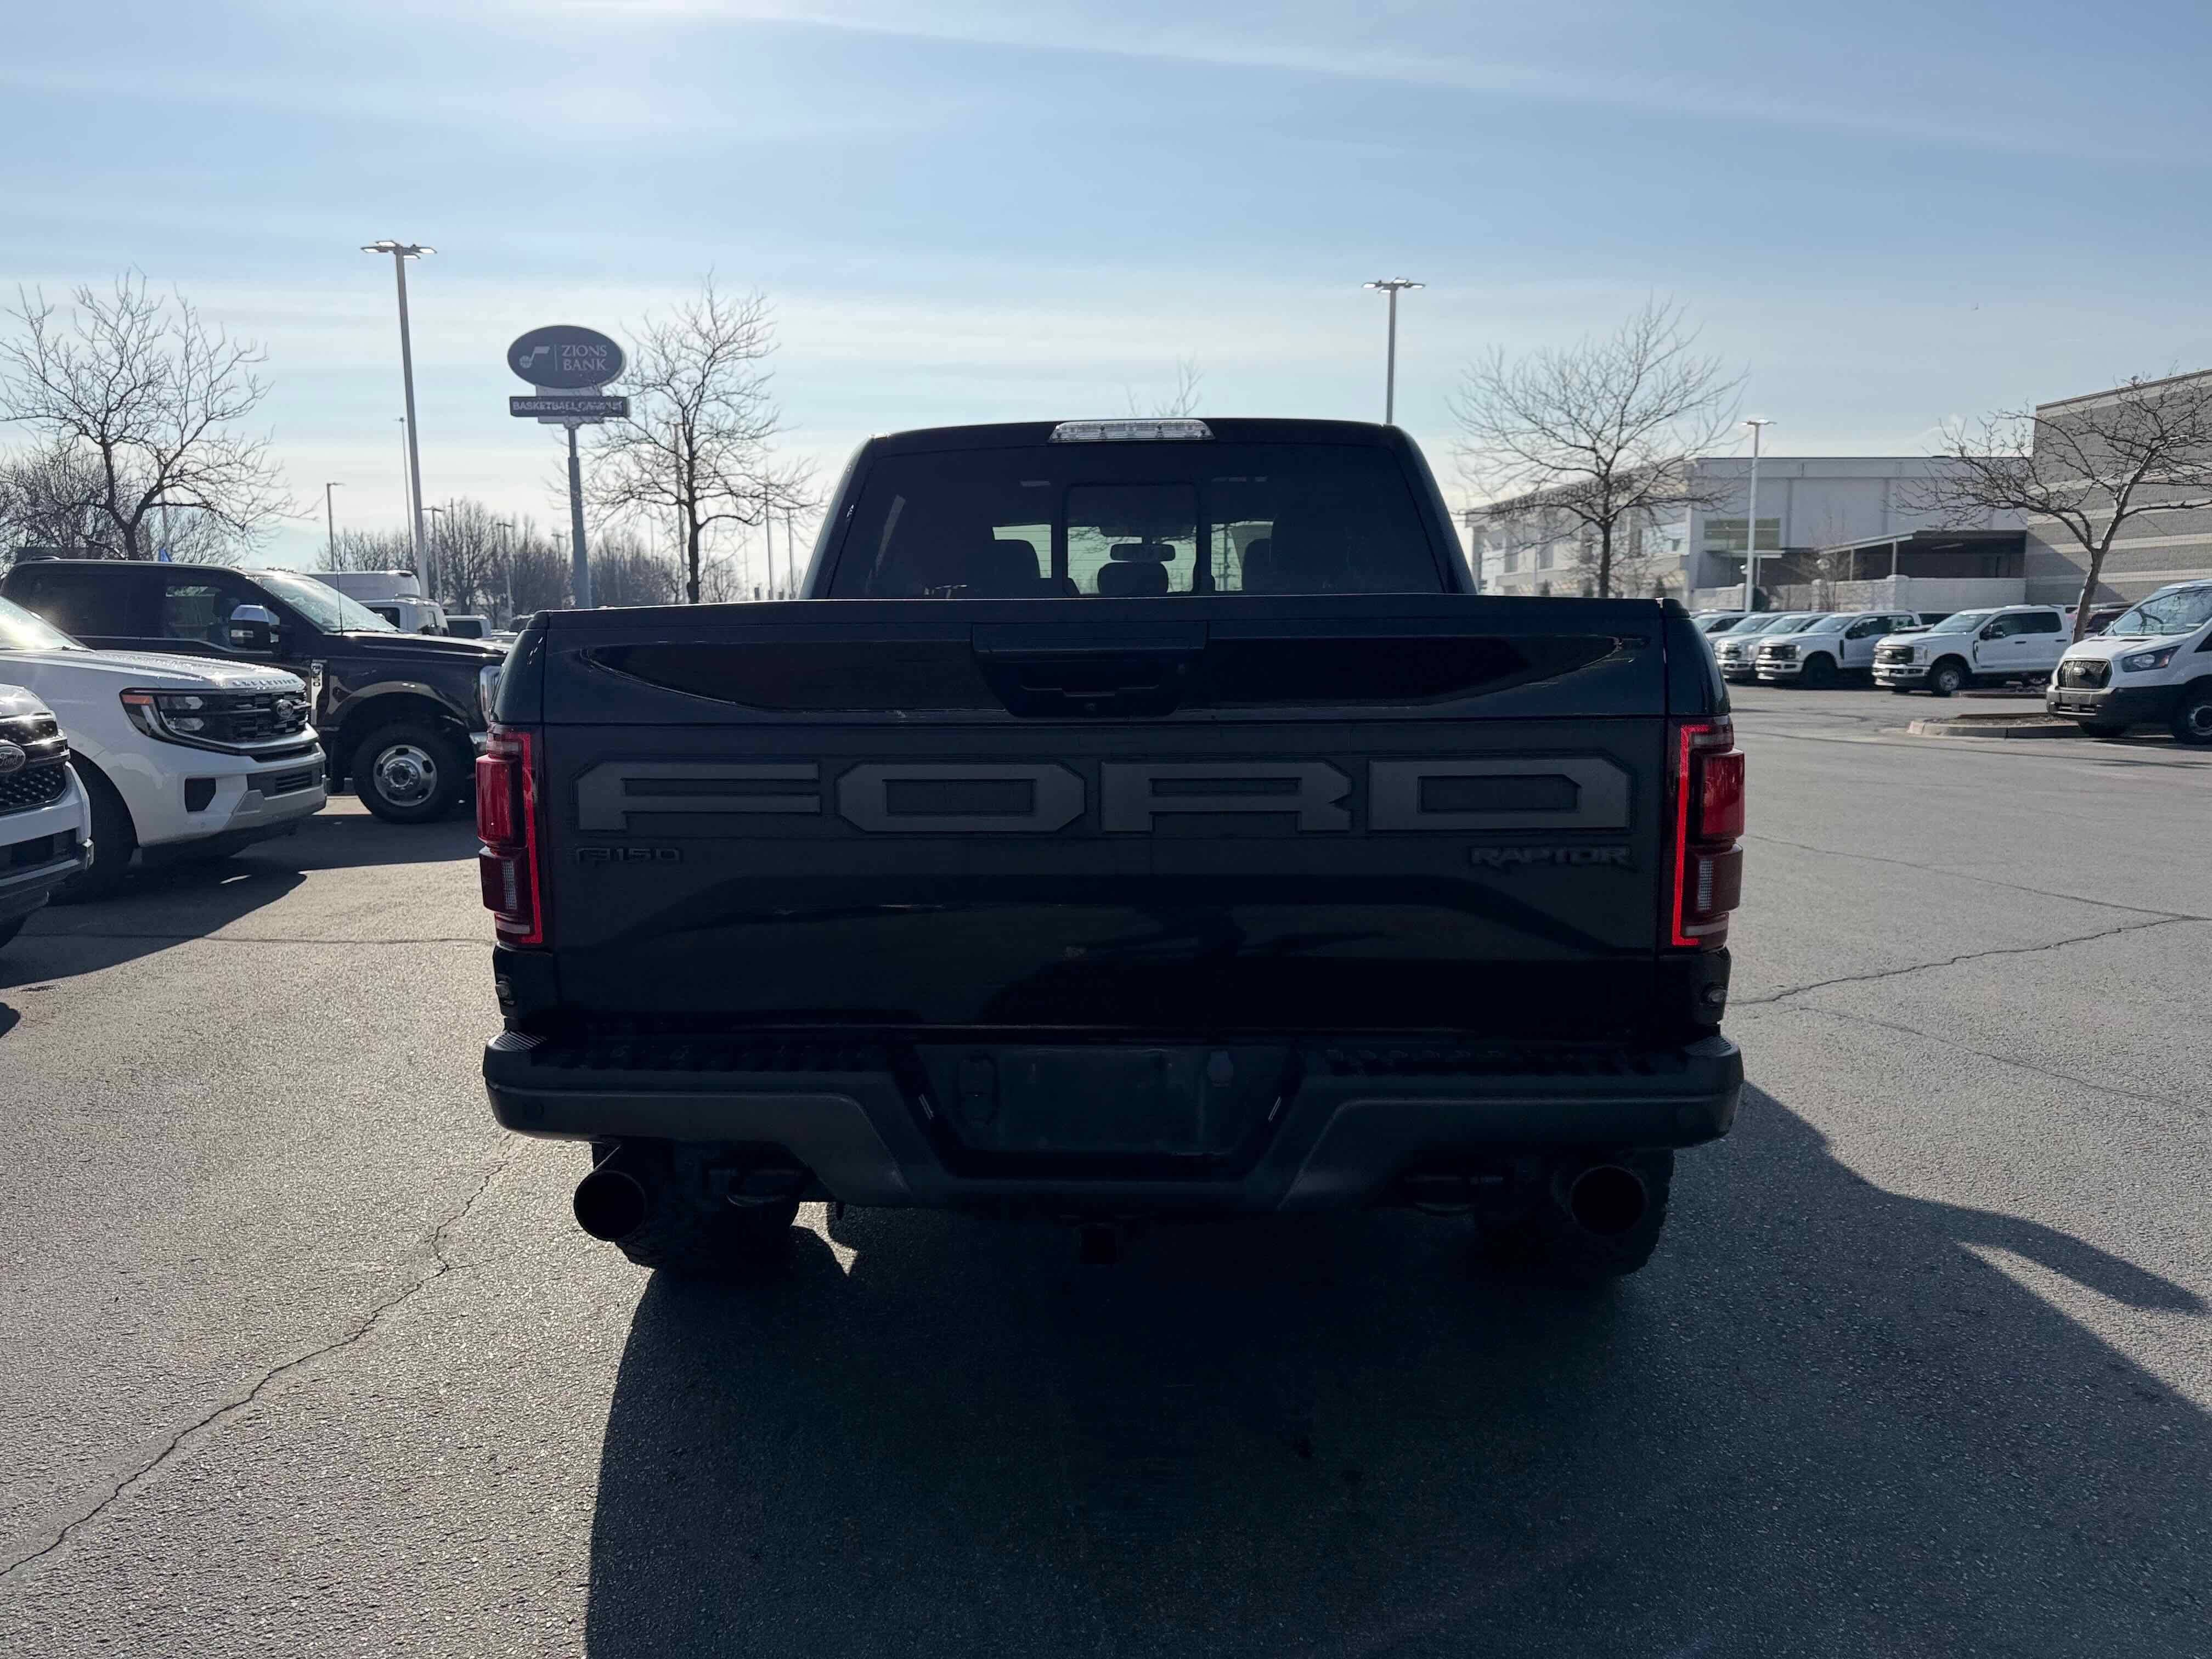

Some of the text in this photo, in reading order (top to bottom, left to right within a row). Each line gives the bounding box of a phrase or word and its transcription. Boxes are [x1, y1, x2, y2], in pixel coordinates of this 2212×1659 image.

[561, 345, 607, 357] ZIONS
[563, 358, 608, 371] BANK
[577, 759, 1630, 833] FORD
[1471, 848, 1630, 867] RAPTOR
